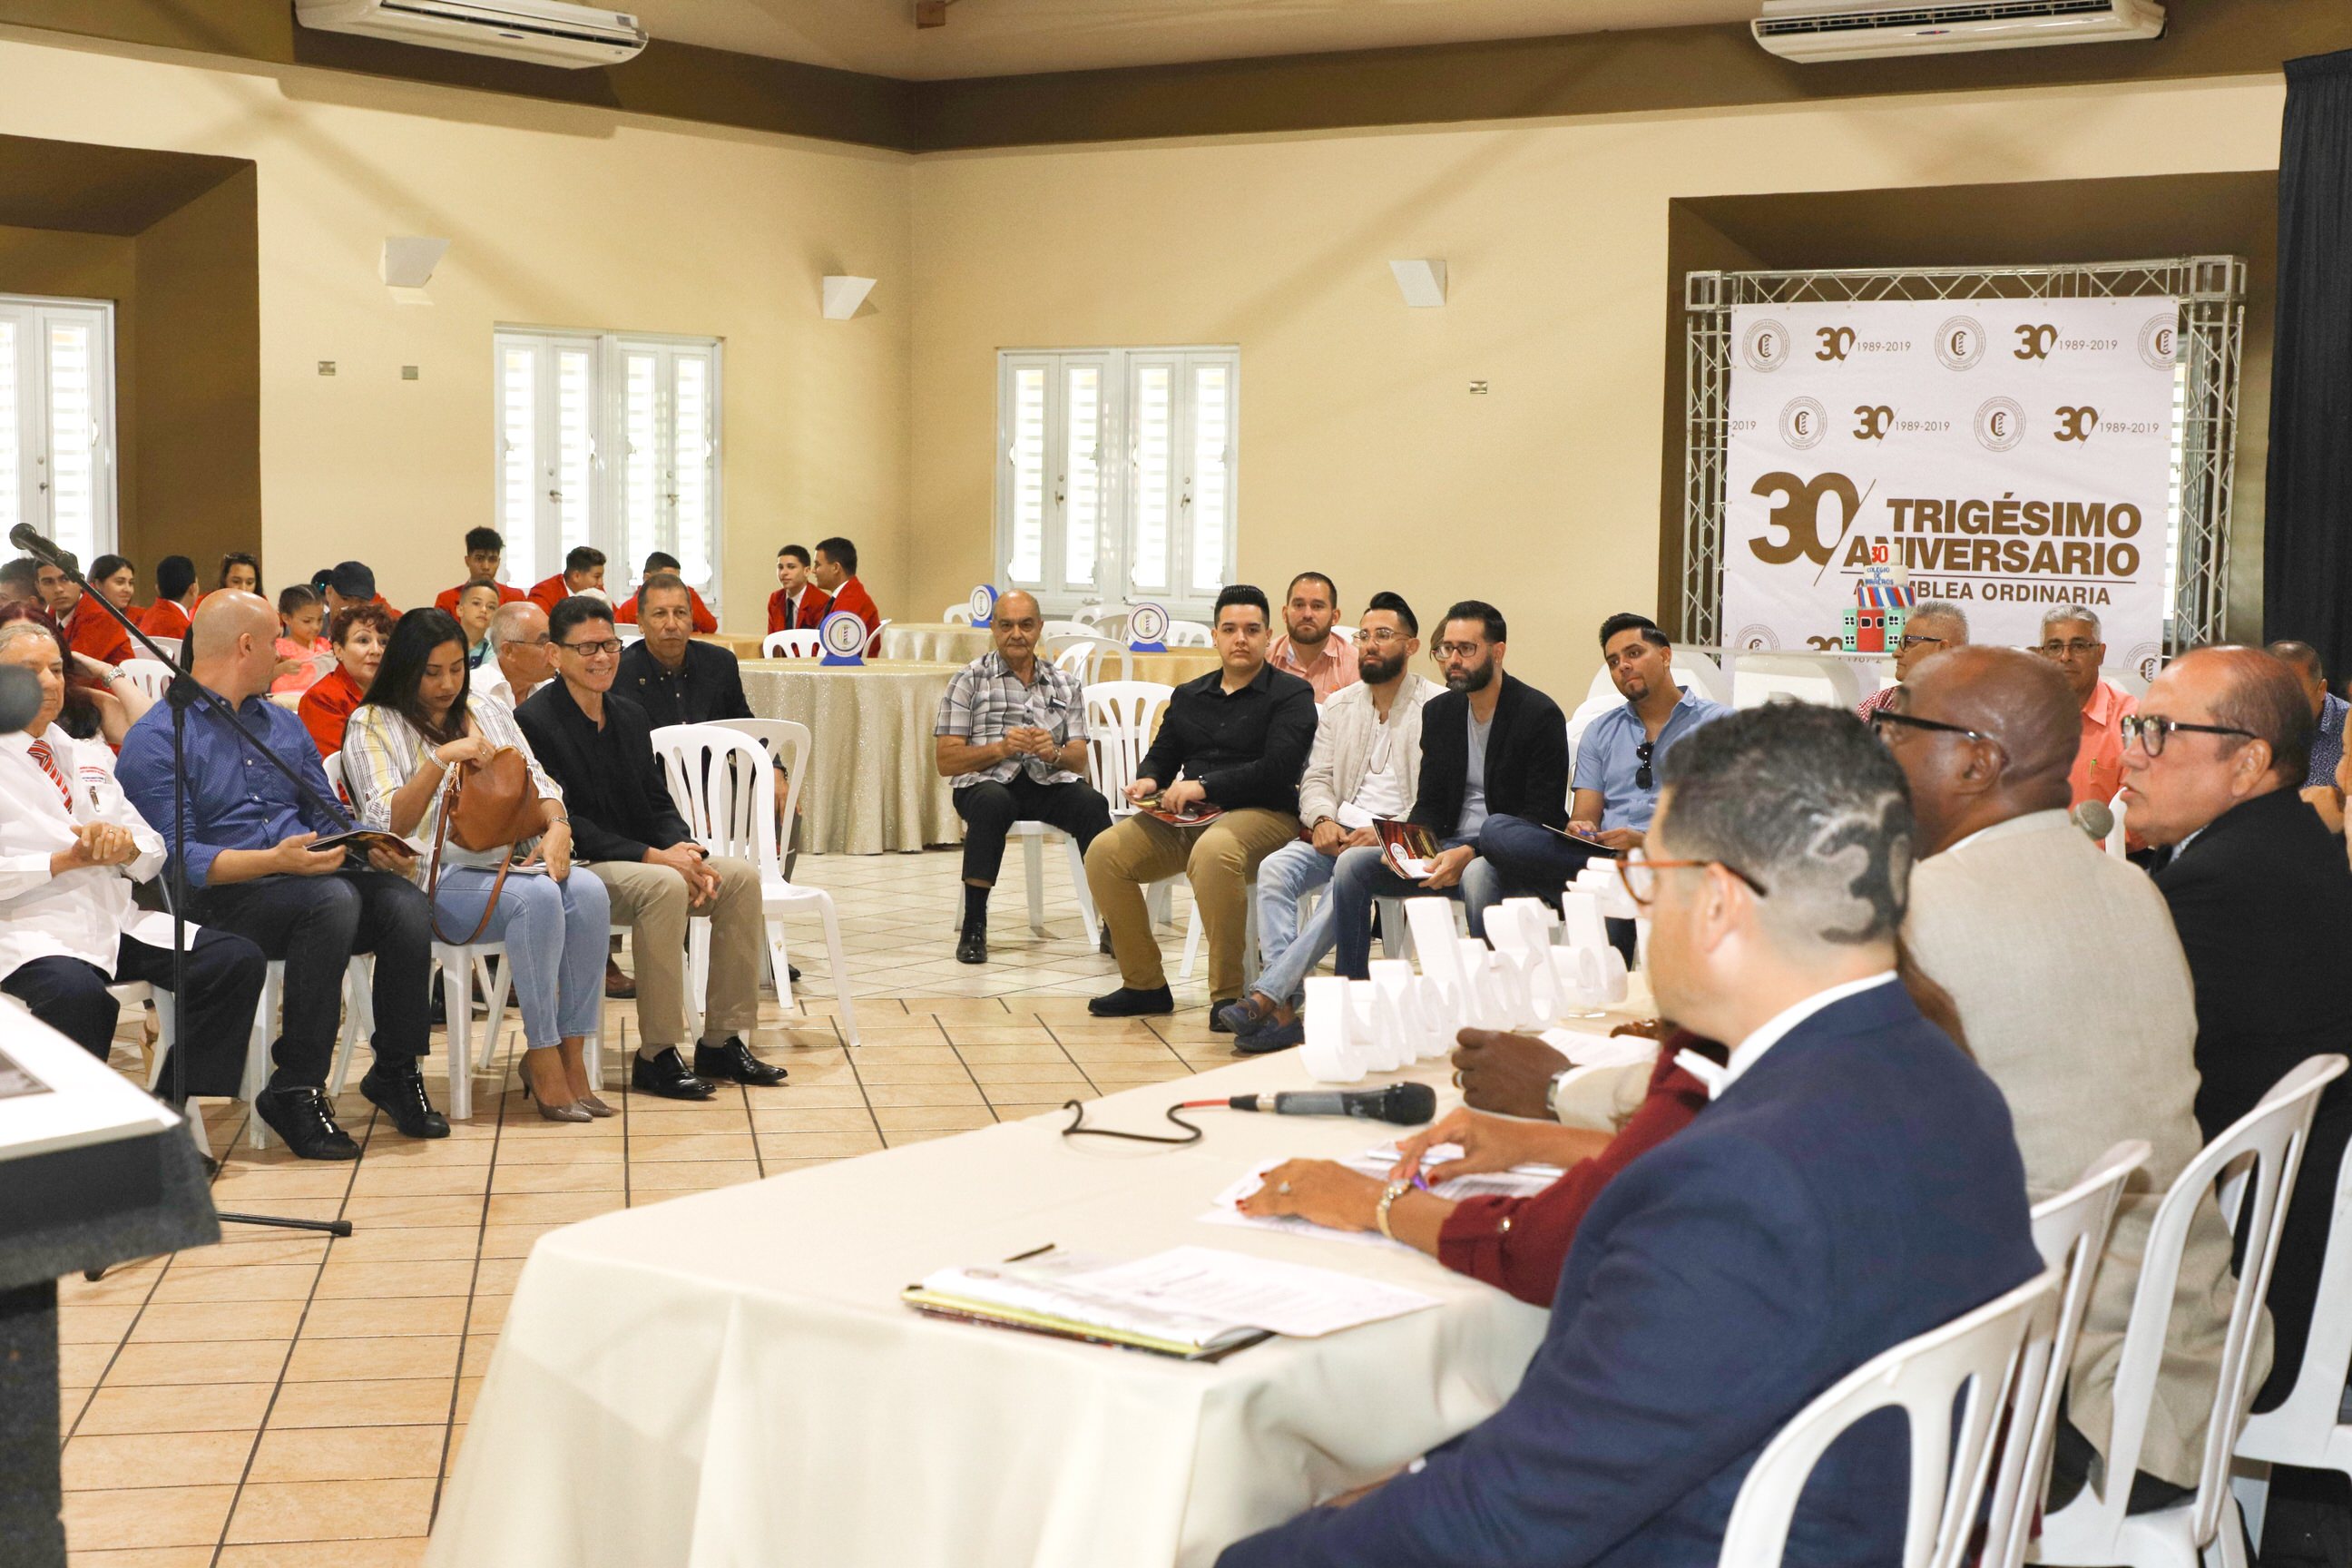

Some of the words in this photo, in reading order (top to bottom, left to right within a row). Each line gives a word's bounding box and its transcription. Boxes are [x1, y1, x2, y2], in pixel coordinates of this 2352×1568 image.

[1815, 327, 1856, 361] 30
[1857, 341, 1911, 352] 1989-2019
[2014, 324, 2058, 360] 30
[2059, 339, 2118, 350] 1989-2019
[1853, 406, 1895, 440] 30
[1896, 421, 1950, 432] 1989-2019
[2053, 406, 2099, 442] 30
[2099, 423, 2160, 433] 1989-2019
[1748, 471, 1861, 566] 30
[1886, 492, 2142, 539] TRIGÉSIMO
[1871, 545, 1888, 563] 30
[1982, 582, 2112, 605] ORDINARIA
